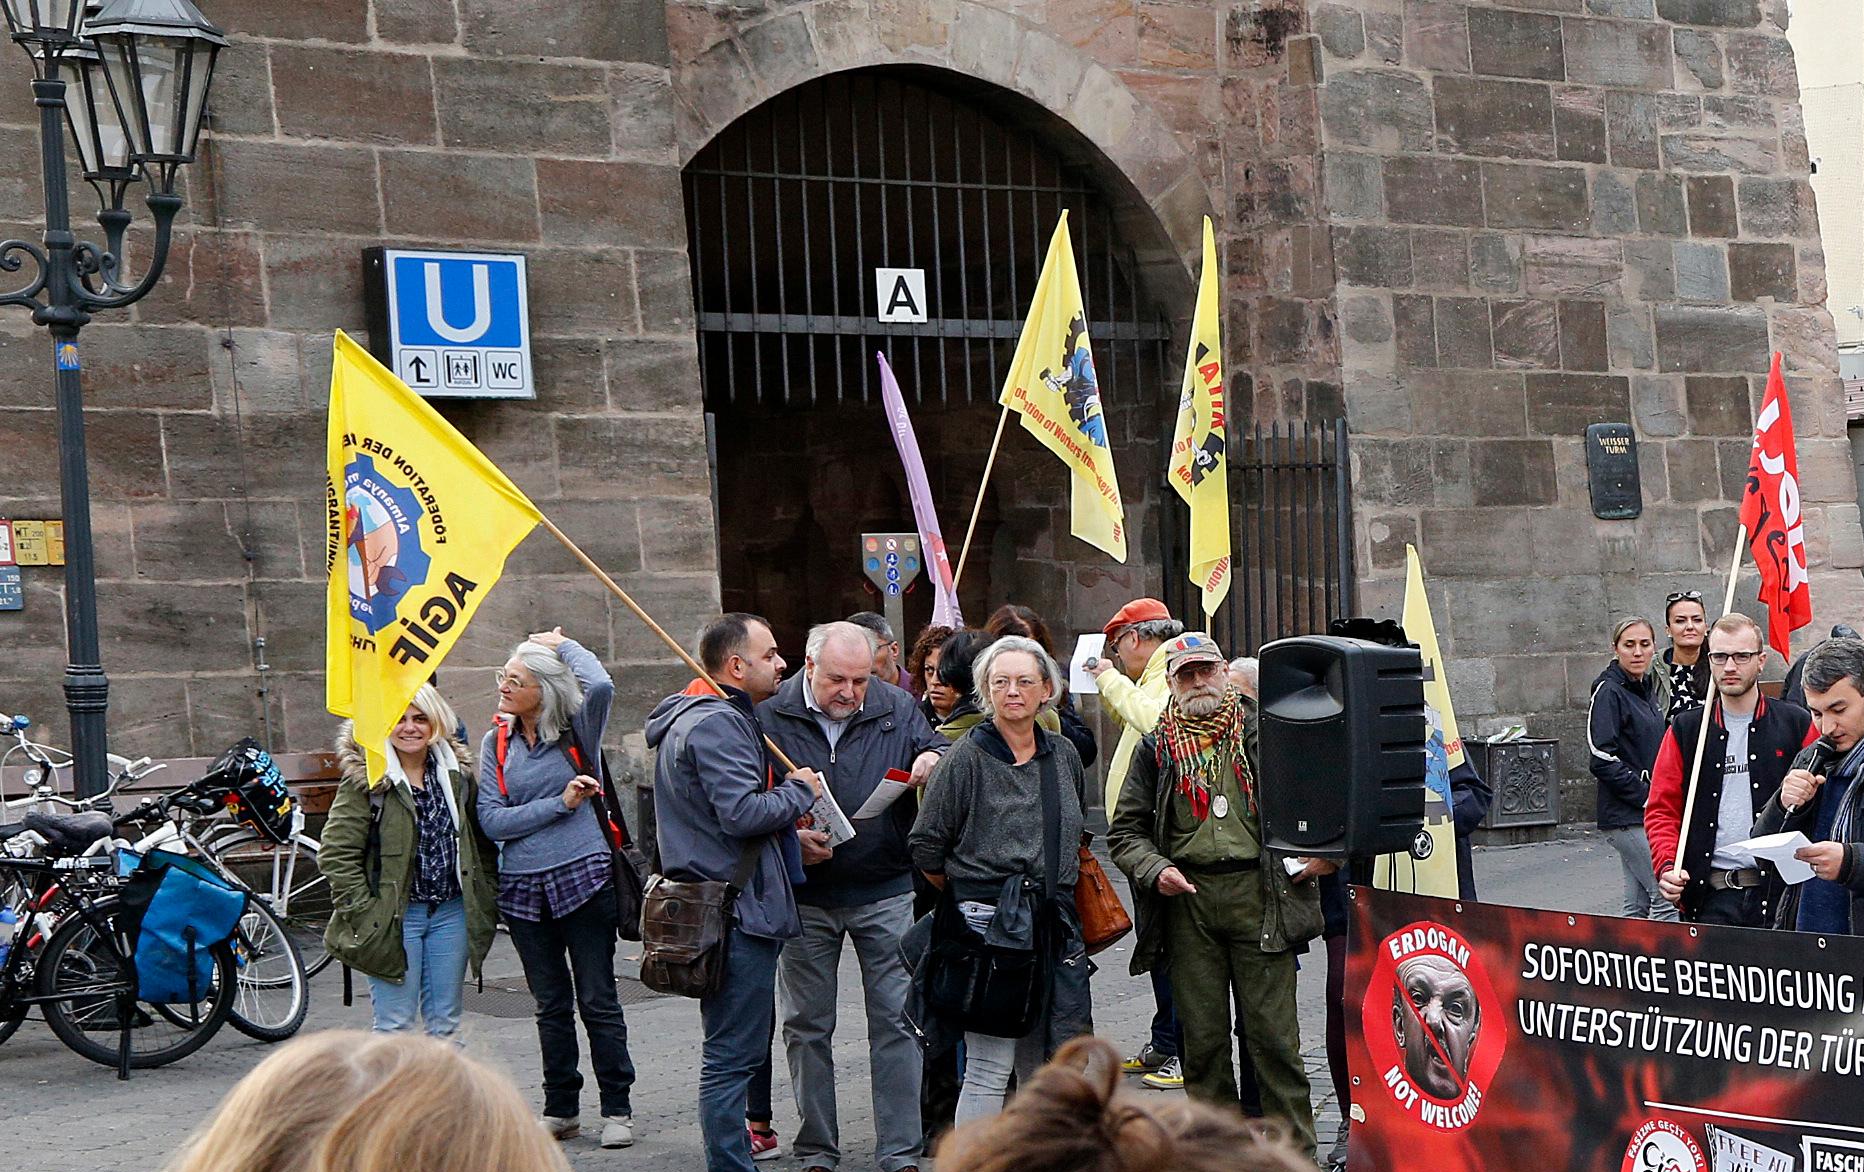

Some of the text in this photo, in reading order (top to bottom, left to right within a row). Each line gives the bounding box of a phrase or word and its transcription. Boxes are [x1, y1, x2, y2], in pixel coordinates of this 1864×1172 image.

[424, 262, 491, 343] U
[886, 275, 920, 316] A
[492, 362, 517, 380] WC
[1599, 437, 1630, 447] WEISSER
[1605, 446, 1627, 455] TURM
[1388, 926, 1471, 970] ERDOGAN
[1521, 942, 1670, 993] SOFORTIGE
[1674, 957, 1856, 1014] BEENDIGUNG
[1517, 999, 1753, 1065] UNTERSTÜTZUNG
[1757, 1027, 1814, 1071] DER
[1383, 1064, 1483, 1129] NOT WELCOME!
[1718, 1133, 1764, 1167] FREE
